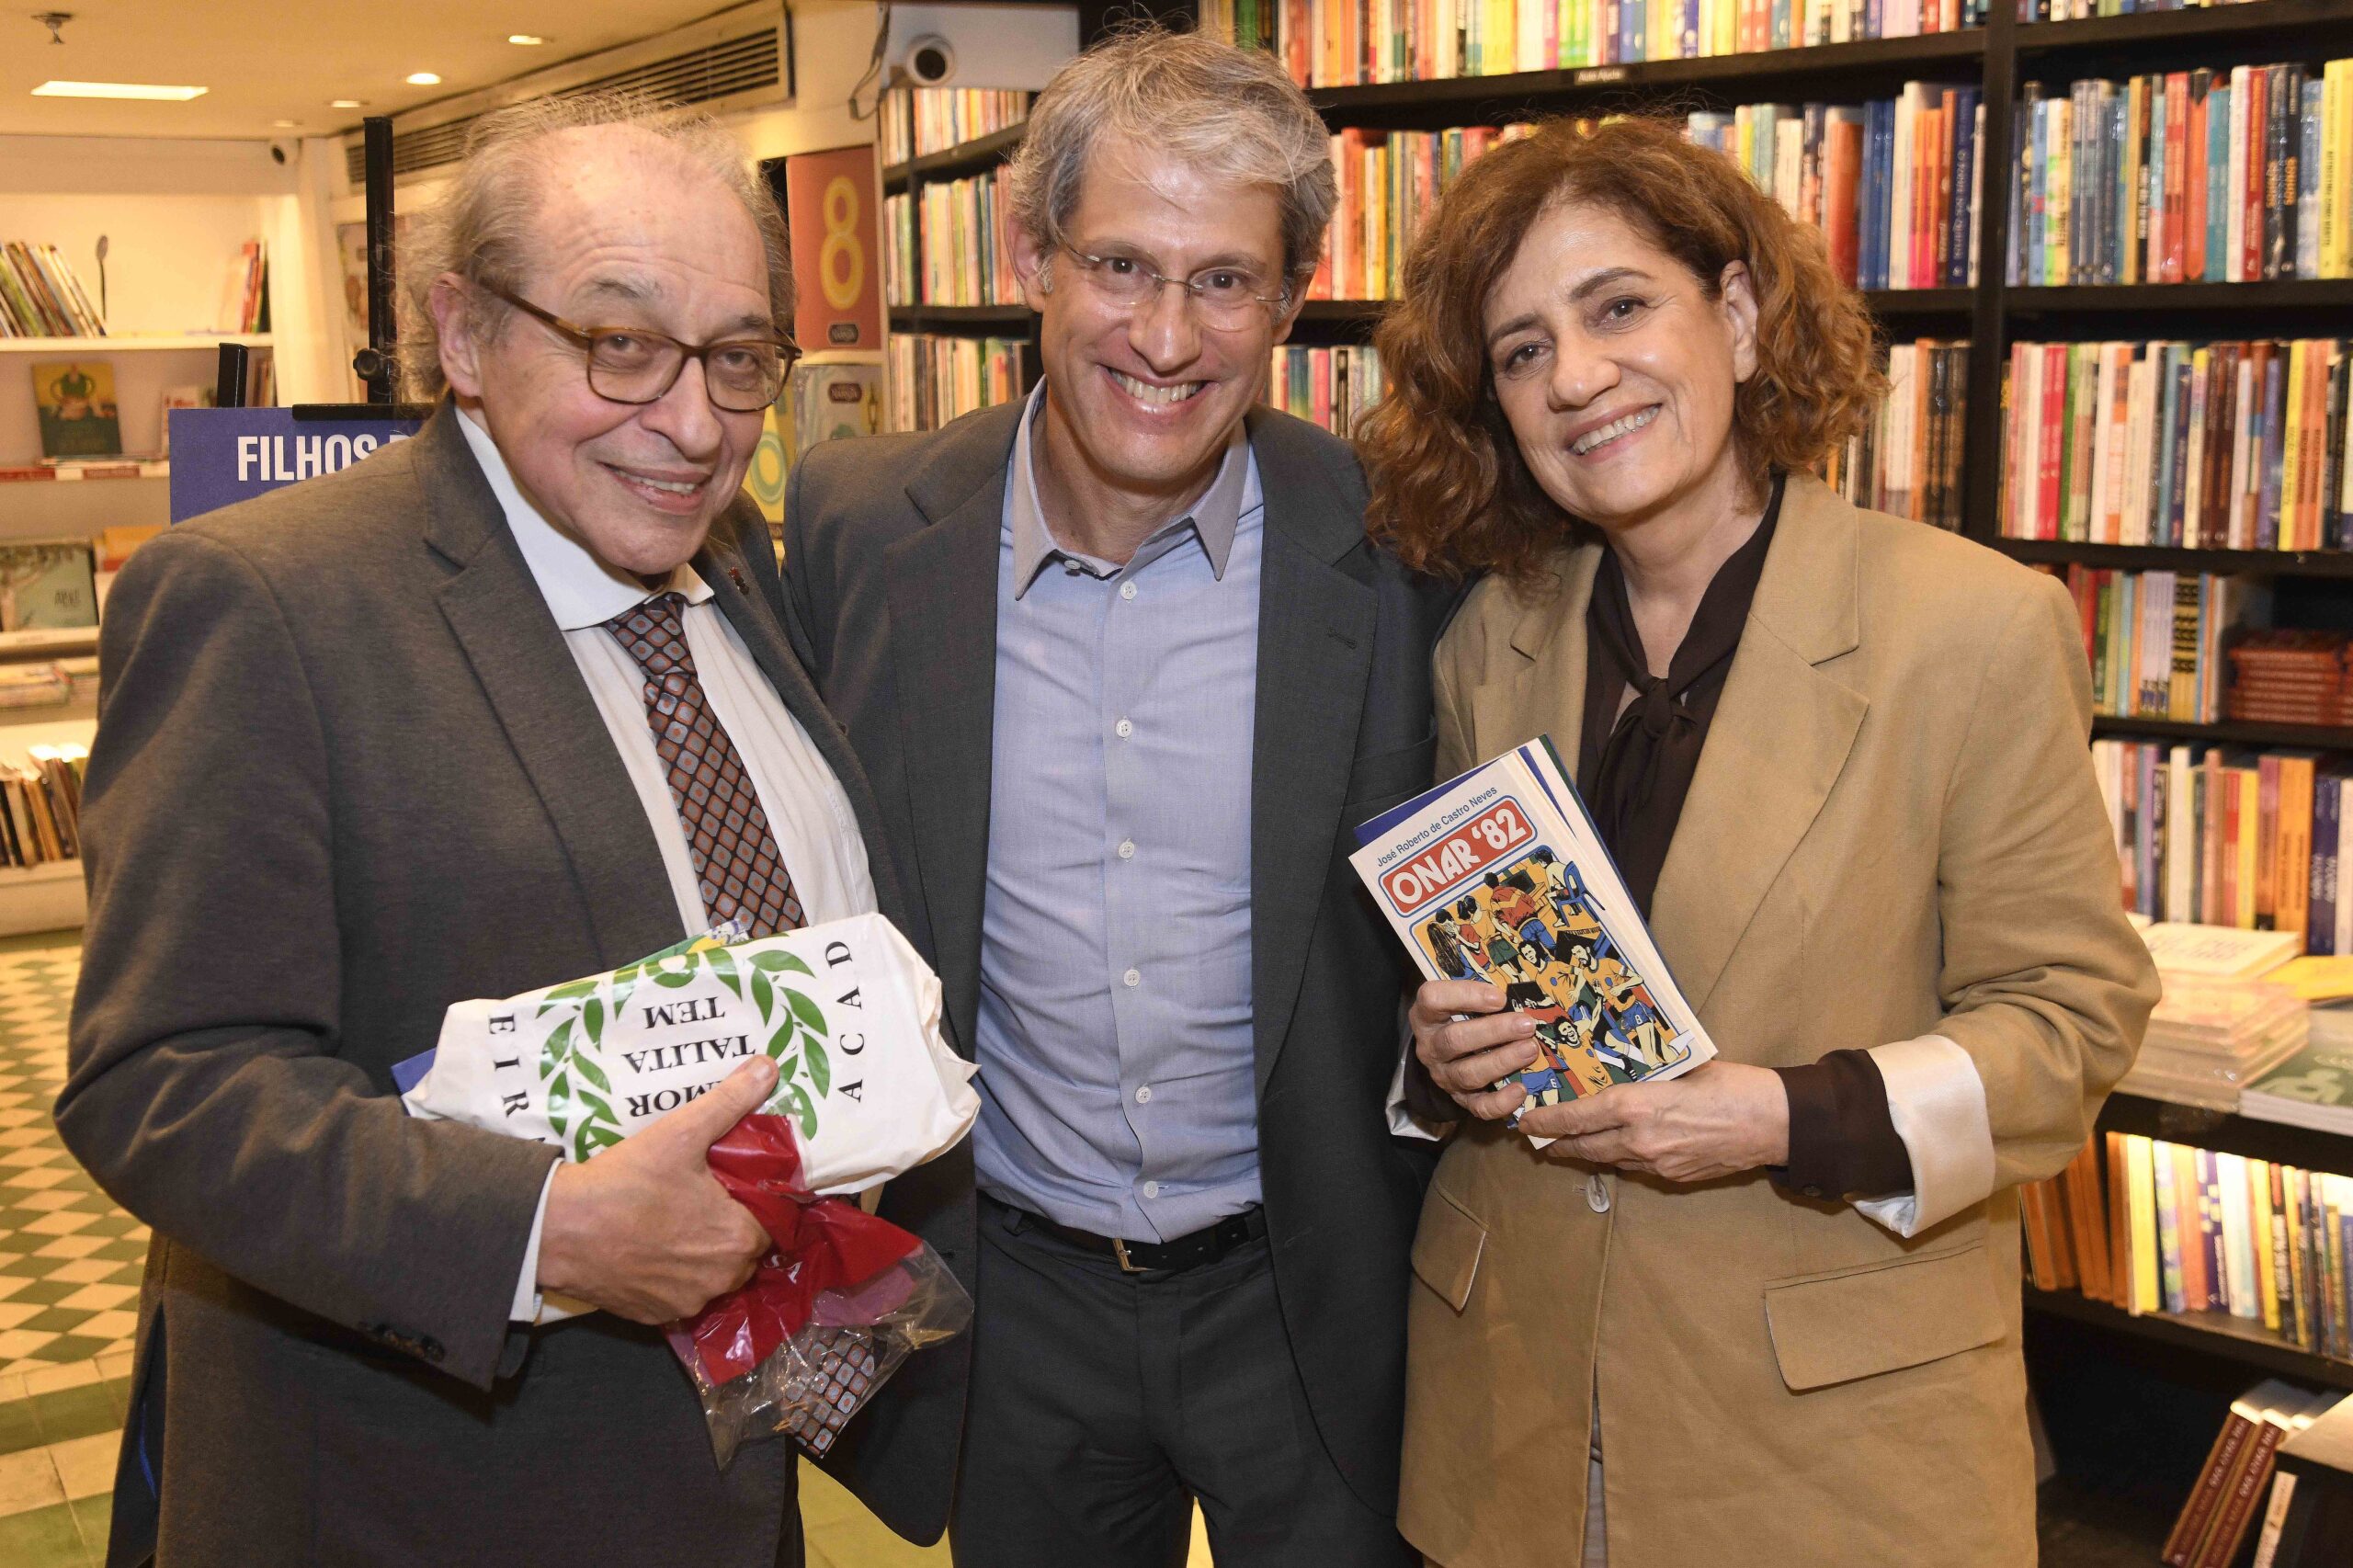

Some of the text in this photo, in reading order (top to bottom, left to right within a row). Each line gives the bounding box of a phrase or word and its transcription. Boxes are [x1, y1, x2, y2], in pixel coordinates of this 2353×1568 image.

[1378, 787, 1497, 867] José Roberto de Castro Neves
[1392, 838, 1481, 904] ONAR
[642, 996, 725, 1029] TEM
[621, 1035, 756, 1074] TALITA
